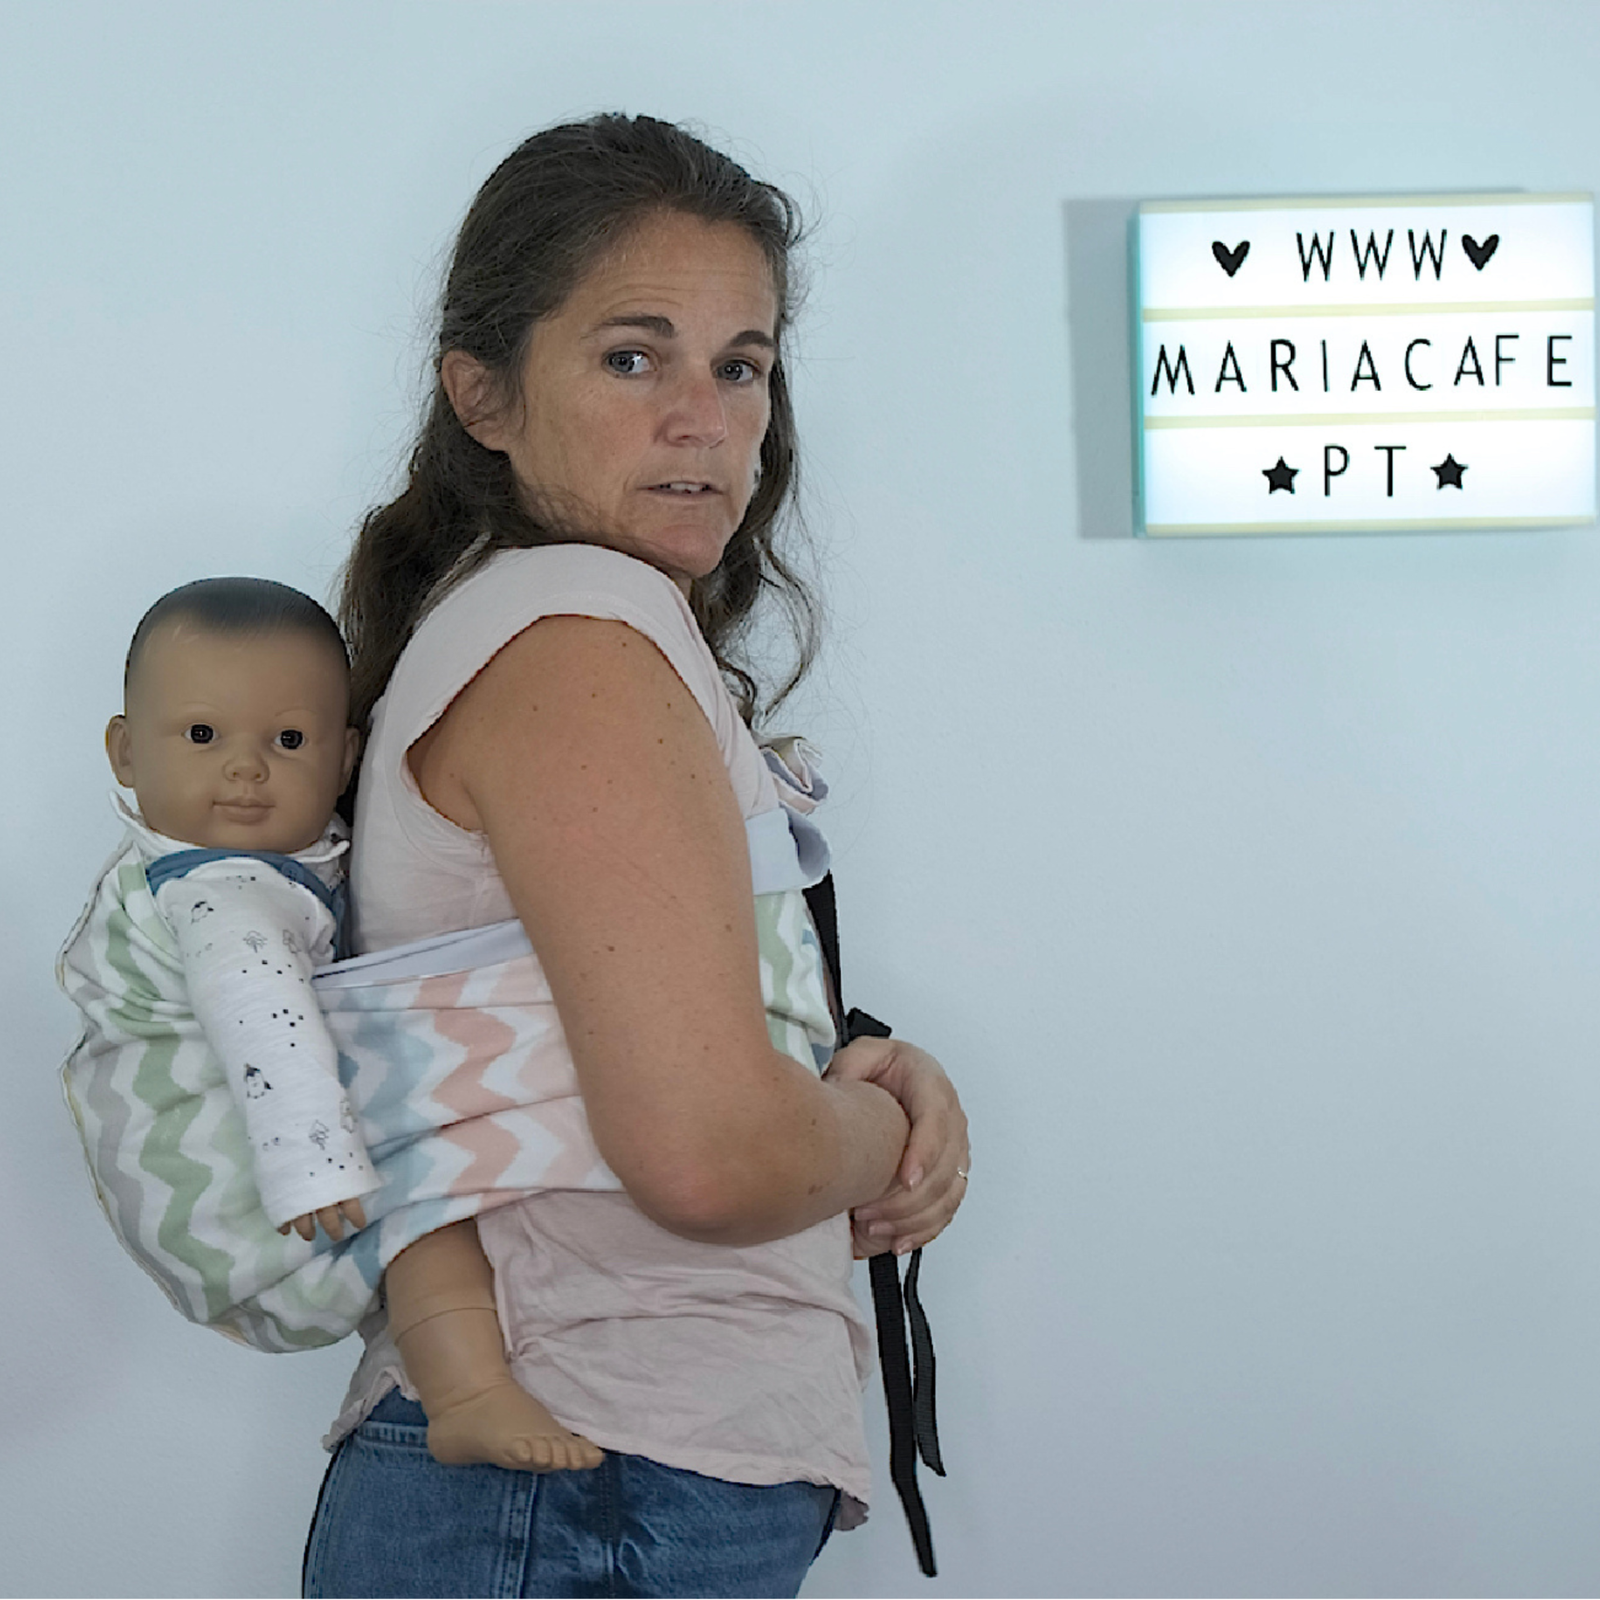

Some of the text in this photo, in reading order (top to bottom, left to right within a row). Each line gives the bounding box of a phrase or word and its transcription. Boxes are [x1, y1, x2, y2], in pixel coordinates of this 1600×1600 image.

[1296, 228, 1448, 282] WWW
[1150, 334, 1573, 396] MARIACAFE
[1323, 445, 1407, 497] PT
